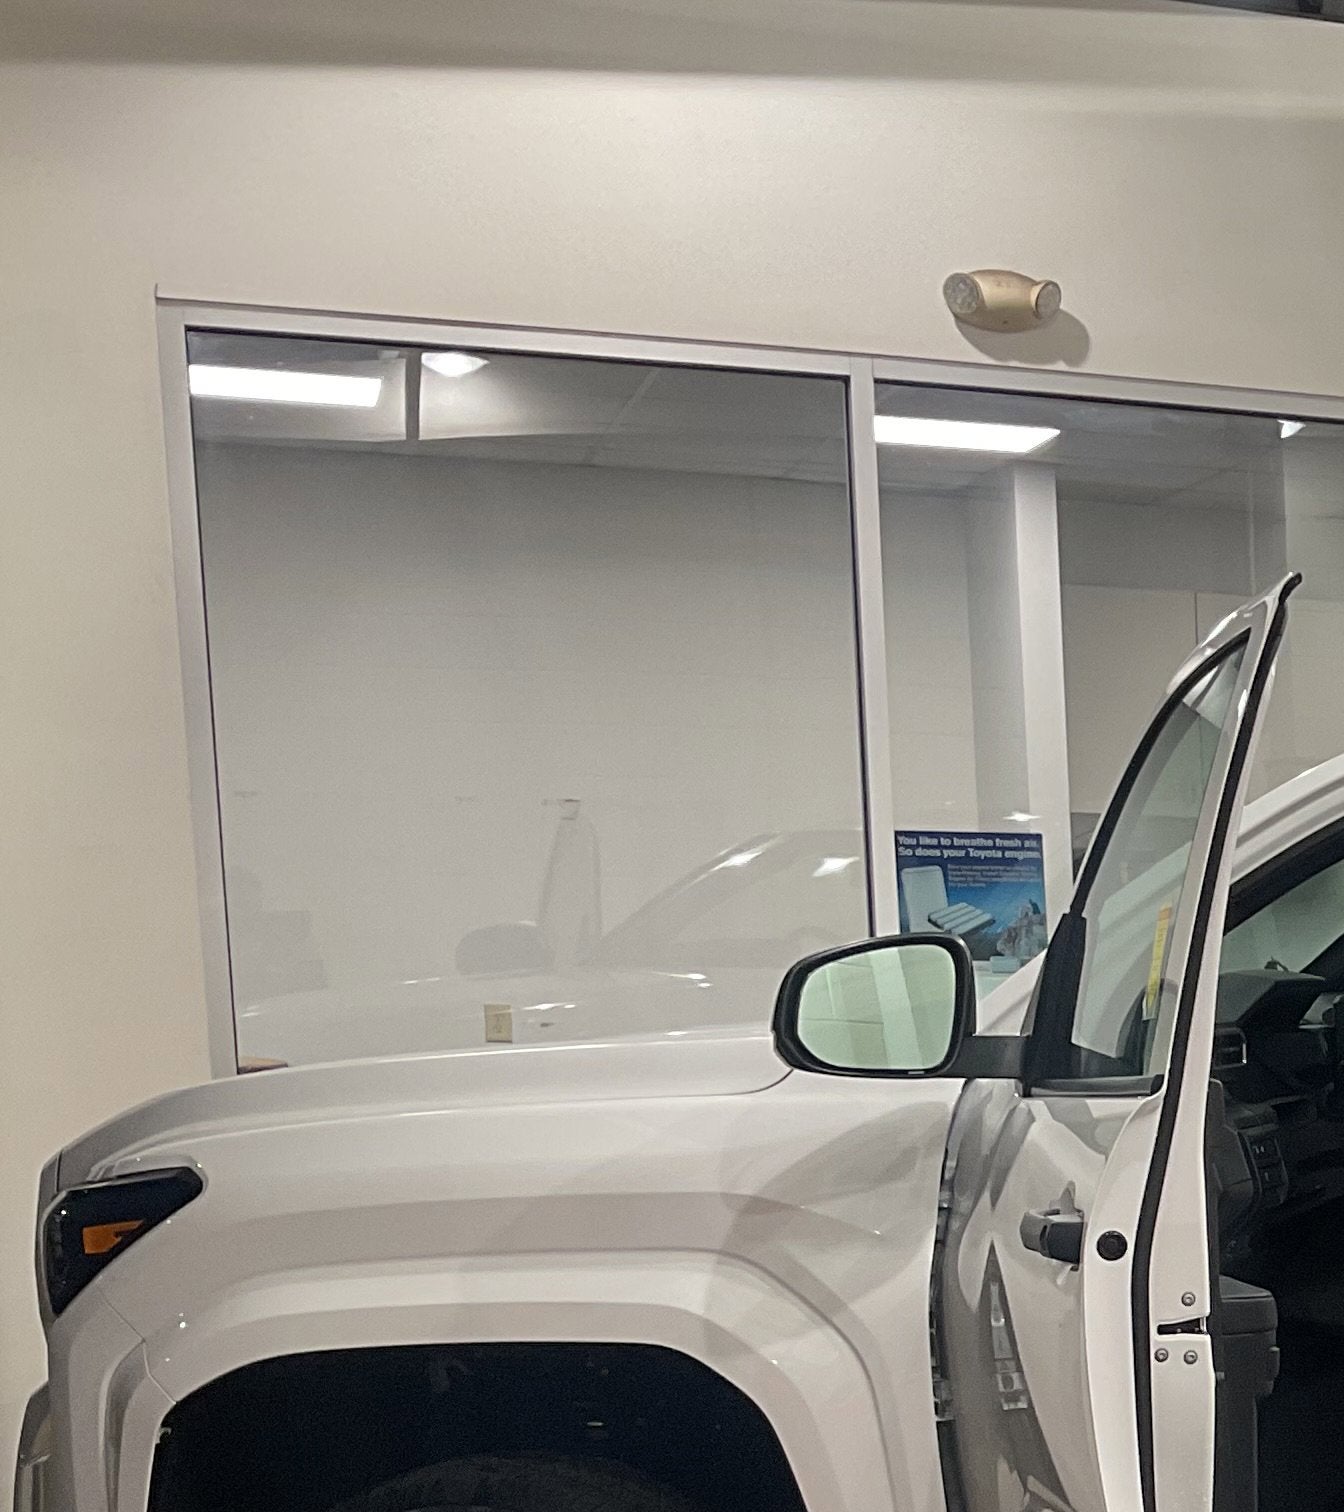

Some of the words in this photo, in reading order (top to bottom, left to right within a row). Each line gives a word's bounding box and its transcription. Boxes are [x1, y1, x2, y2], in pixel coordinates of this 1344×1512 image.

[898, 836, 917, 845] You
[919, 836, 938, 845] like
[940, 837, 952, 846] to
[953, 837, 994, 846] breathe
[995, 838, 1022, 847] fresh
[898, 847, 913, 856] So
[914, 848, 941, 857] does
[942, 849, 966, 859] your
[967, 848, 1002, 860] Toyota
